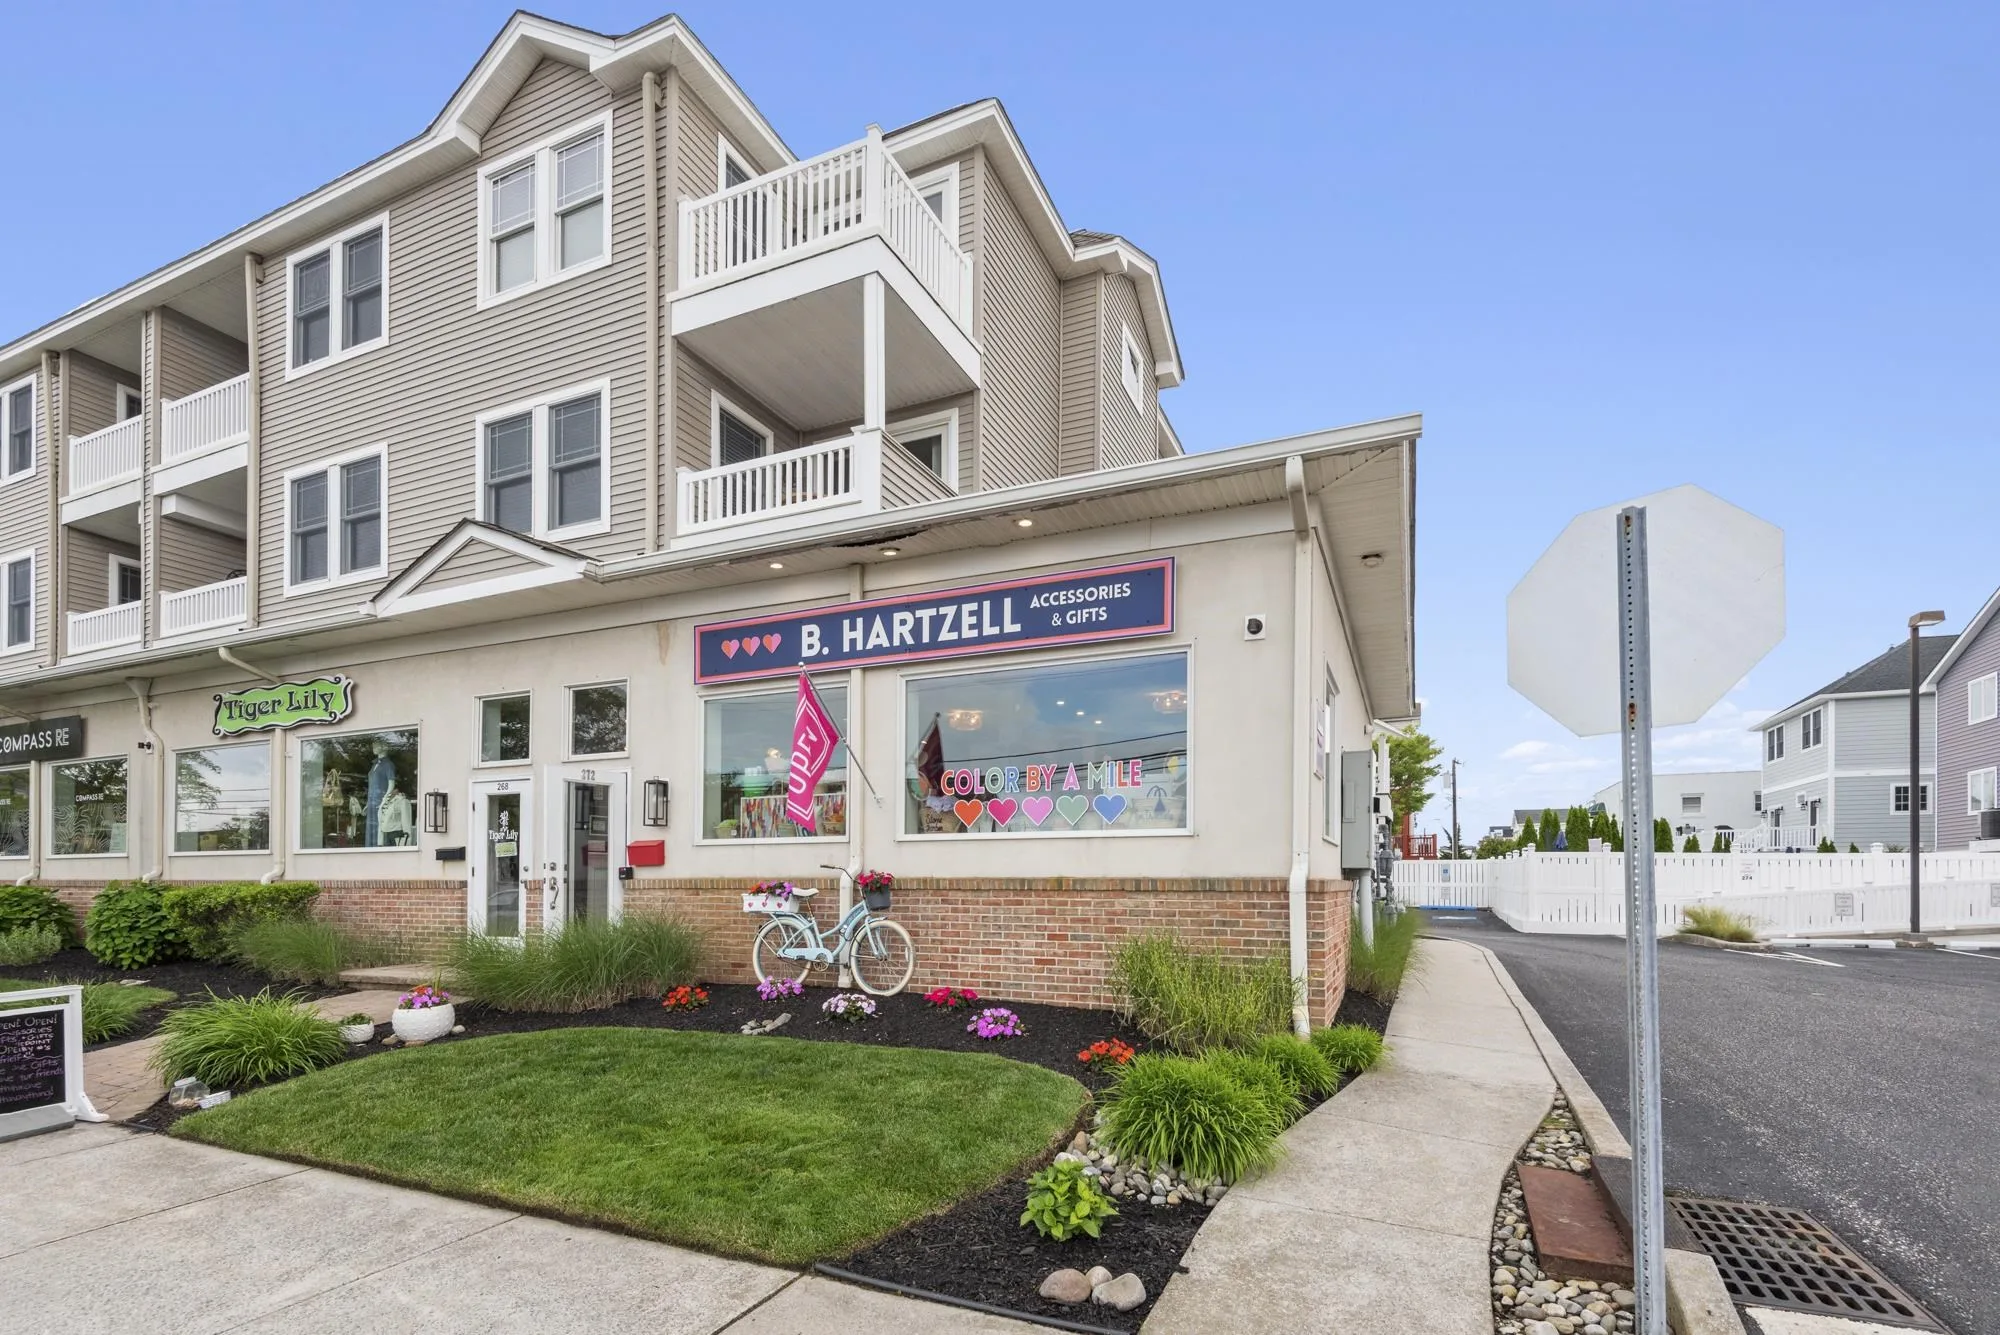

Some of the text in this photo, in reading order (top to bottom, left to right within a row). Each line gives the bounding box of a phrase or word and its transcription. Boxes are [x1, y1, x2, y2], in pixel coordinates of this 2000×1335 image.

[1029, 582, 1131, 609] ACCESSORIES
[801, 597, 1022, 657] B. HARTZELL
[1051, 606, 1108, 627] & GIFTS
[223, 689, 335, 721] Tiger Lily
[55, 727, 70, 747] RE
[941, 759, 1143, 796] COLOR BY A MILE
